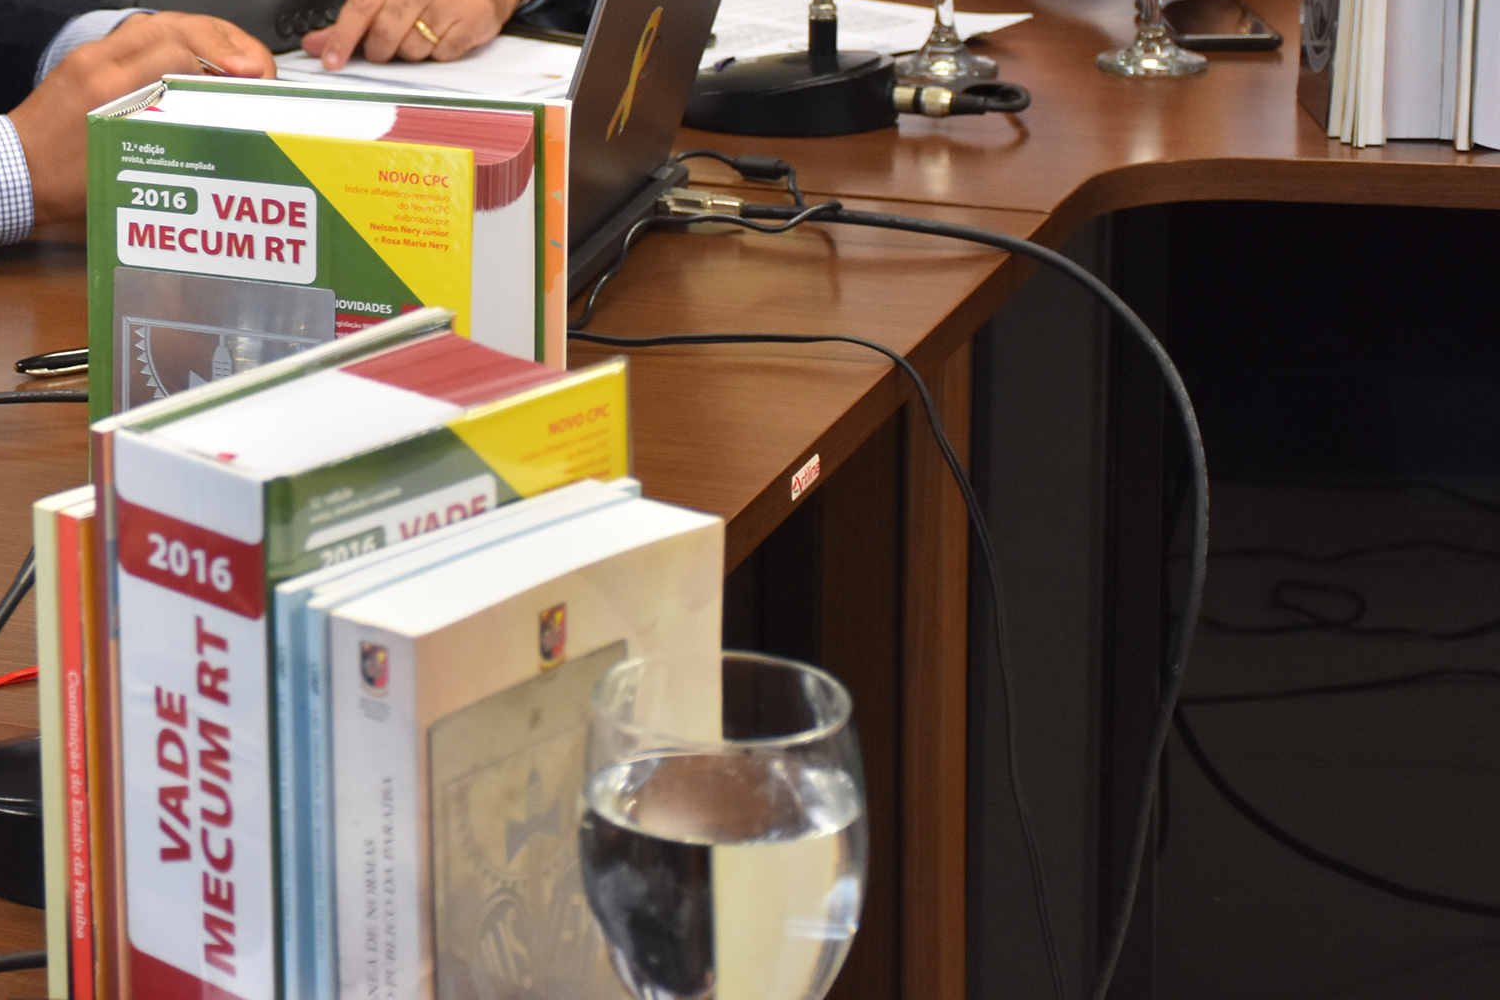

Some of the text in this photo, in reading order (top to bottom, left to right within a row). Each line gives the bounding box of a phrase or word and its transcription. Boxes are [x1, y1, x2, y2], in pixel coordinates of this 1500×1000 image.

[138, 143, 166, 156] edição
[121, 155, 145, 165] revista,
[145, 157, 179, 168] atualizada
[184, 161, 216, 171] ampliada
[378, 170, 449, 188] NOVO CPC
[130, 187, 307, 228] 2016 VADE
[397, 201, 449, 214] do Novo CPC
[393, 213, 450, 227] elaborado por
[369, 222, 450, 238] Nelson Nery Júnior
[128, 222, 307, 265] MECUM RT
[380, 236, 401, 246] Rosa
[402, 238, 427, 248] Maria
[428, 241, 450, 252] Nery
[147, 533, 234, 593] 2016
[154, 685, 193, 863] VADE
[66, 670, 88, 939] Constituição do Estado da Paraíba
[195, 615, 238, 978] MECUM RT
